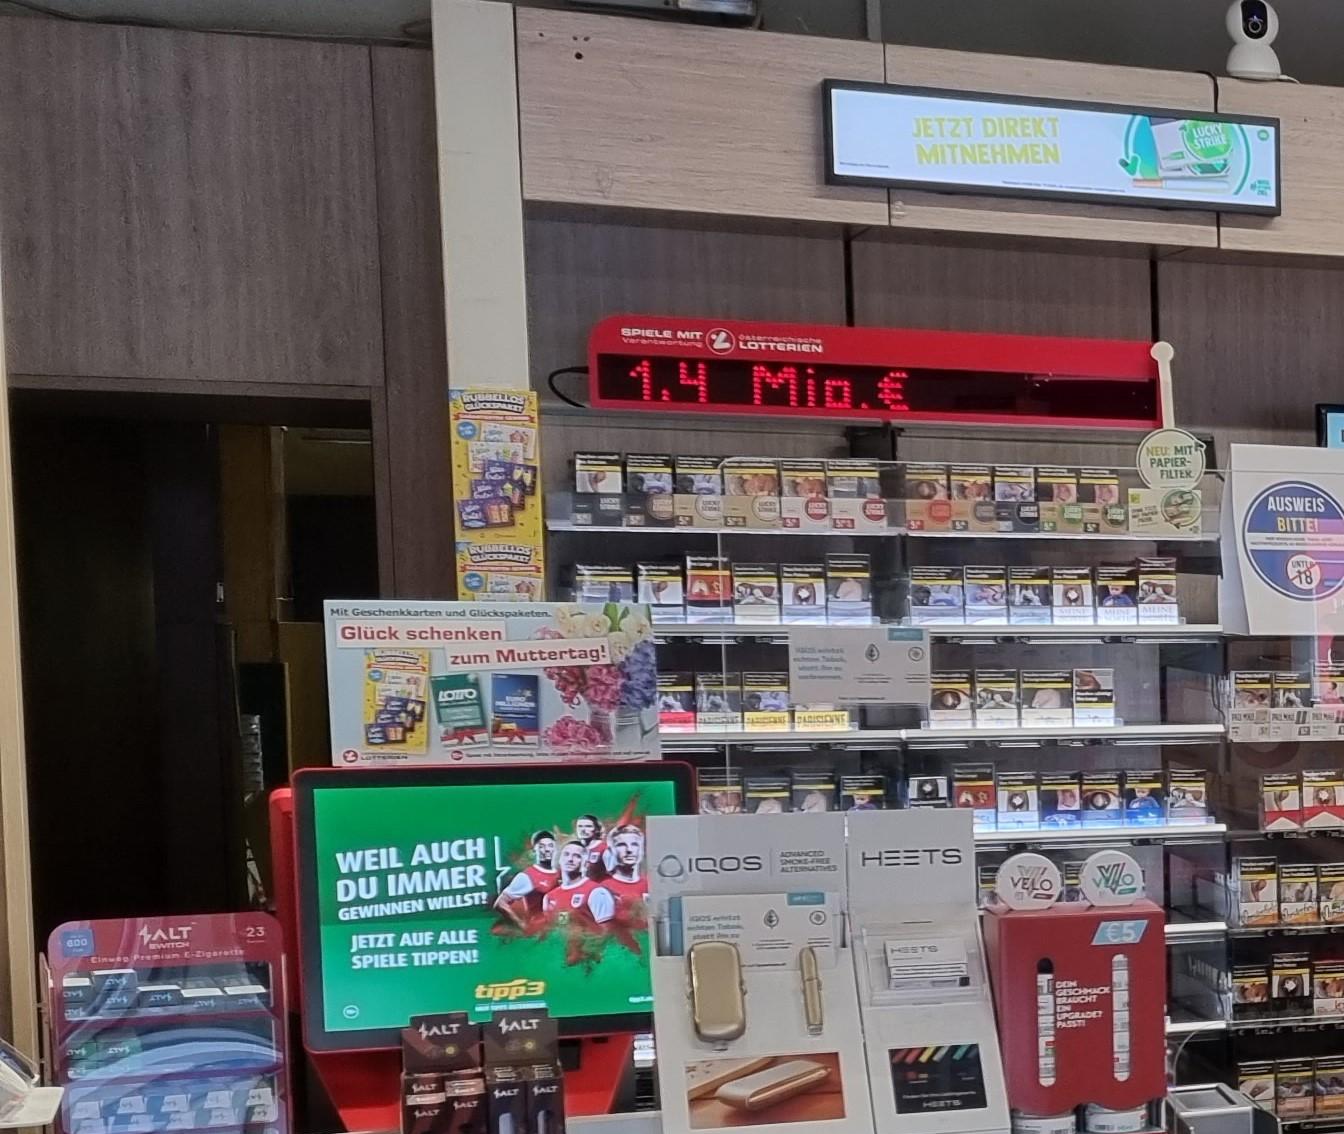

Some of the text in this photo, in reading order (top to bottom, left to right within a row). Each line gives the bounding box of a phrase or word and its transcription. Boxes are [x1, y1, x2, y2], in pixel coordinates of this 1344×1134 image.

[913, 116, 1061, 138] JETZT DIREKT
[1192, 122, 1224, 138] LUCKY
[916, 143, 1061, 164] MITNEHMEN
[621, 328, 703, 340] SPIELE MIT
[739, 341, 823, 353] LOTTERIEN
[1174, 446, 1192, 455] MIT
[1150, 458, 1191, 467] PAPIER-
[1267, 496, 1325, 513] AUSWEIS
[1277, 517, 1319, 533] BITTE!
[330, 607, 552, 620] Mit Geschenkkarten und Glückspaketen.
[340, 625, 502, 641] Glück schenken
[449, 644, 606, 666] zum Muttertag!
[437, 688, 476, 702] LOTTO
[336, 837, 486, 875] WEIL AUCH
[687, 848, 963, 875] IQOS HEETS
[779, 864, 838, 874] ALTERNATIVES
[337, 865, 486, 902] DU IMMER
[338, 892, 488, 921] GEWINNEN WILLST!
[1104, 920, 1137, 942] €5
[350, 929, 478, 953] JETZT AUF ALLE
[351, 949, 479, 970] SPIELE TIPPEN!
[475, 978, 545, 1000] tipp3
[1055, 980, 1078, 988] DEIN
